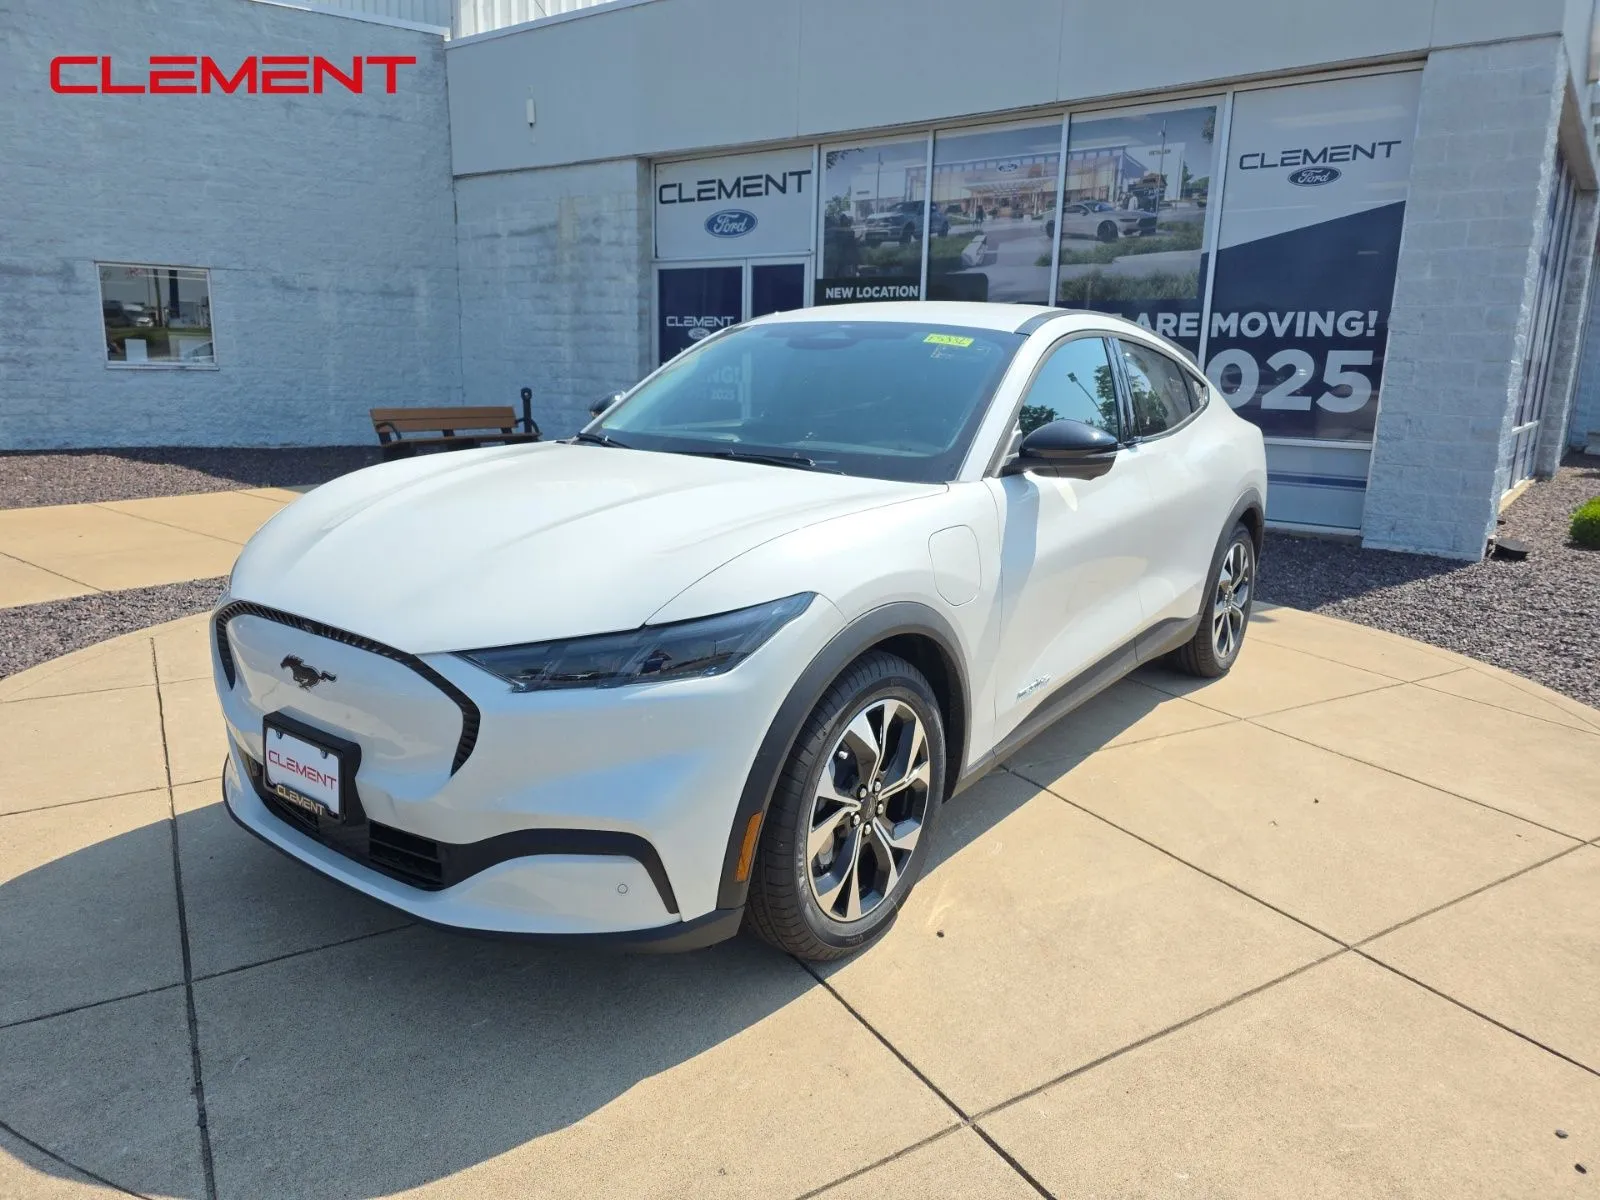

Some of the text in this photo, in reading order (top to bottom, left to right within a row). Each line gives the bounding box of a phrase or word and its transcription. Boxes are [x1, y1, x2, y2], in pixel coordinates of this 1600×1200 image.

[1239, 140, 1402, 170] CLEMENT
[658, 169, 811, 205] CLEMENT
[1297, 166, 1329, 184] Ford
[712, 212, 748, 234] Ford
[825, 285, 919, 299] NEW LOCATION
[665, 315, 734, 328] CLEMENT
[1135, 310, 1379, 338] ARE MOVING!
[1204, 348, 1374, 413] 025
[268, 750, 337, 790] CLEMENT
[277, 785, 325, 816] CLEMENT
